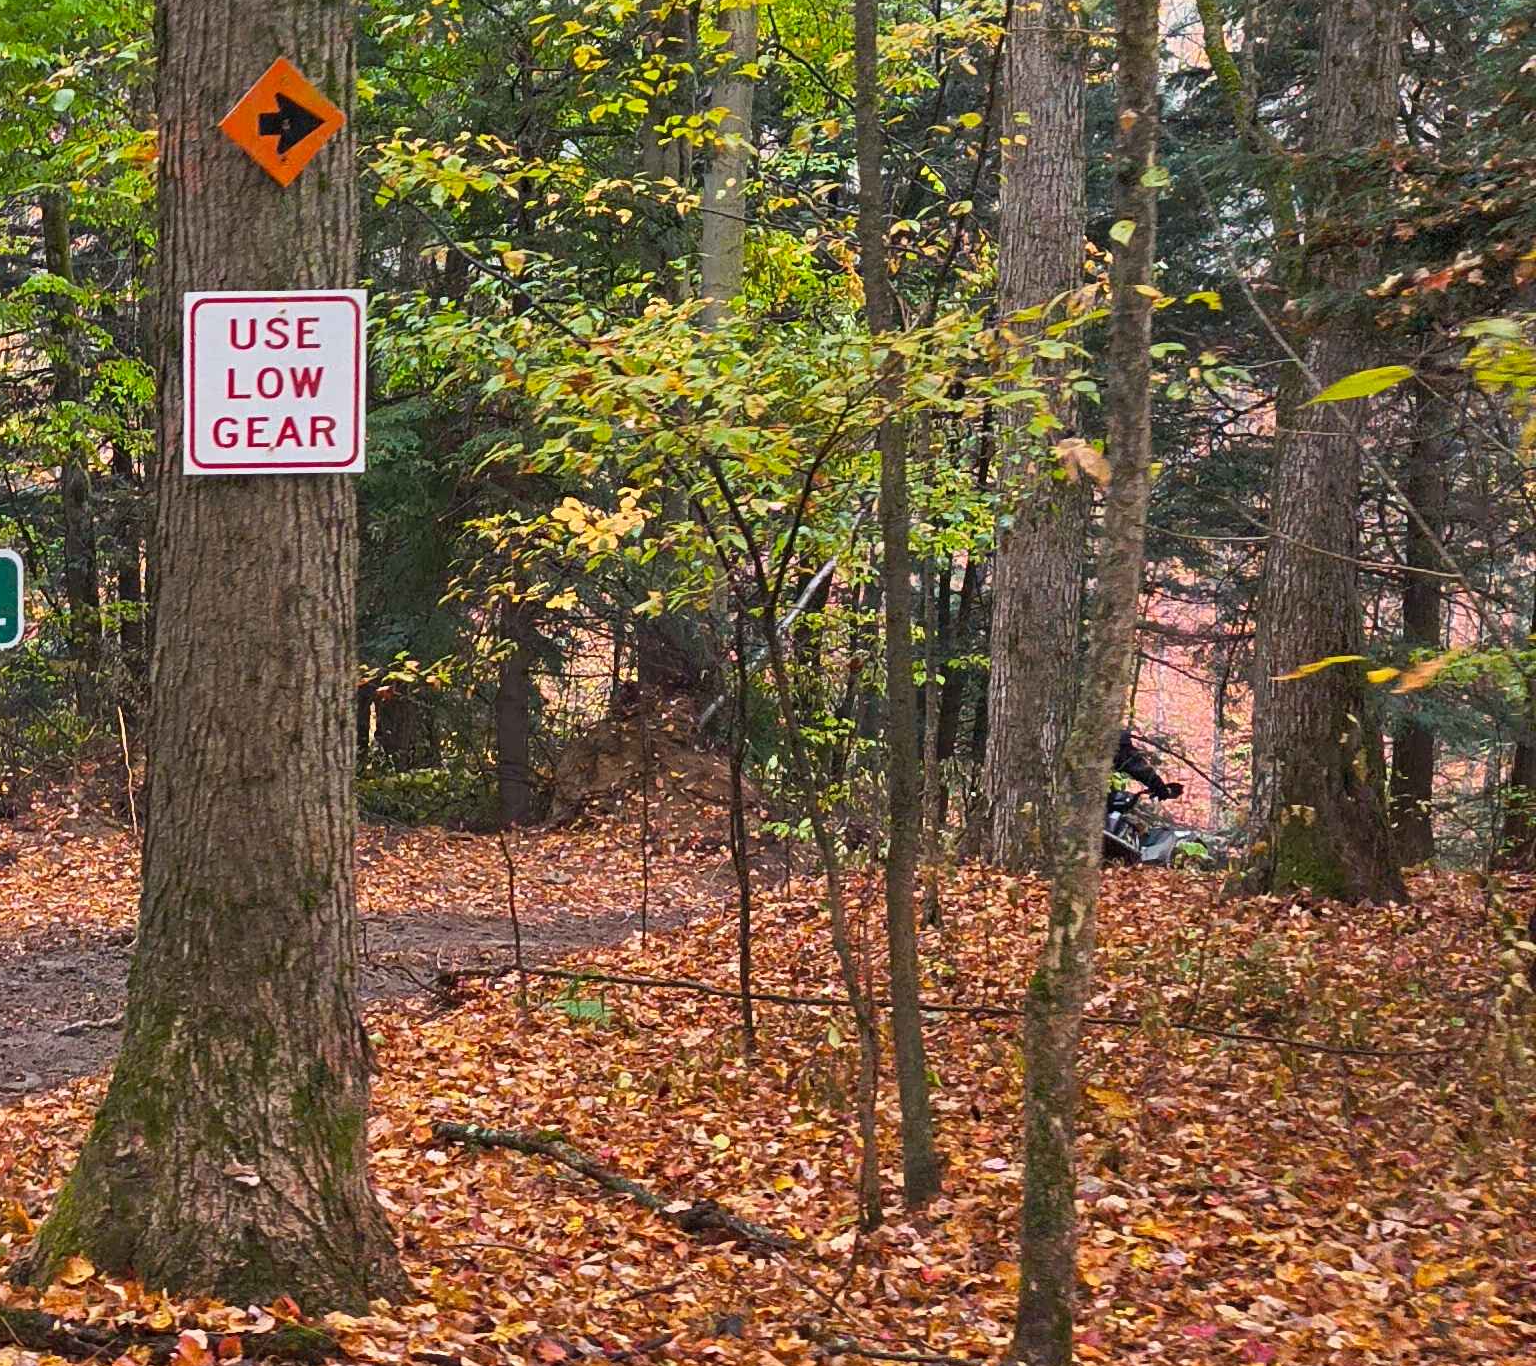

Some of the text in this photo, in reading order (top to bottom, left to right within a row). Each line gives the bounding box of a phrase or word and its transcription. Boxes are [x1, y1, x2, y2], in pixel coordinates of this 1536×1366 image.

[229, 317, 321, 350] USE
[227, 367, 325, 399] LOW
[213, 416, 337, 448] GEAR
